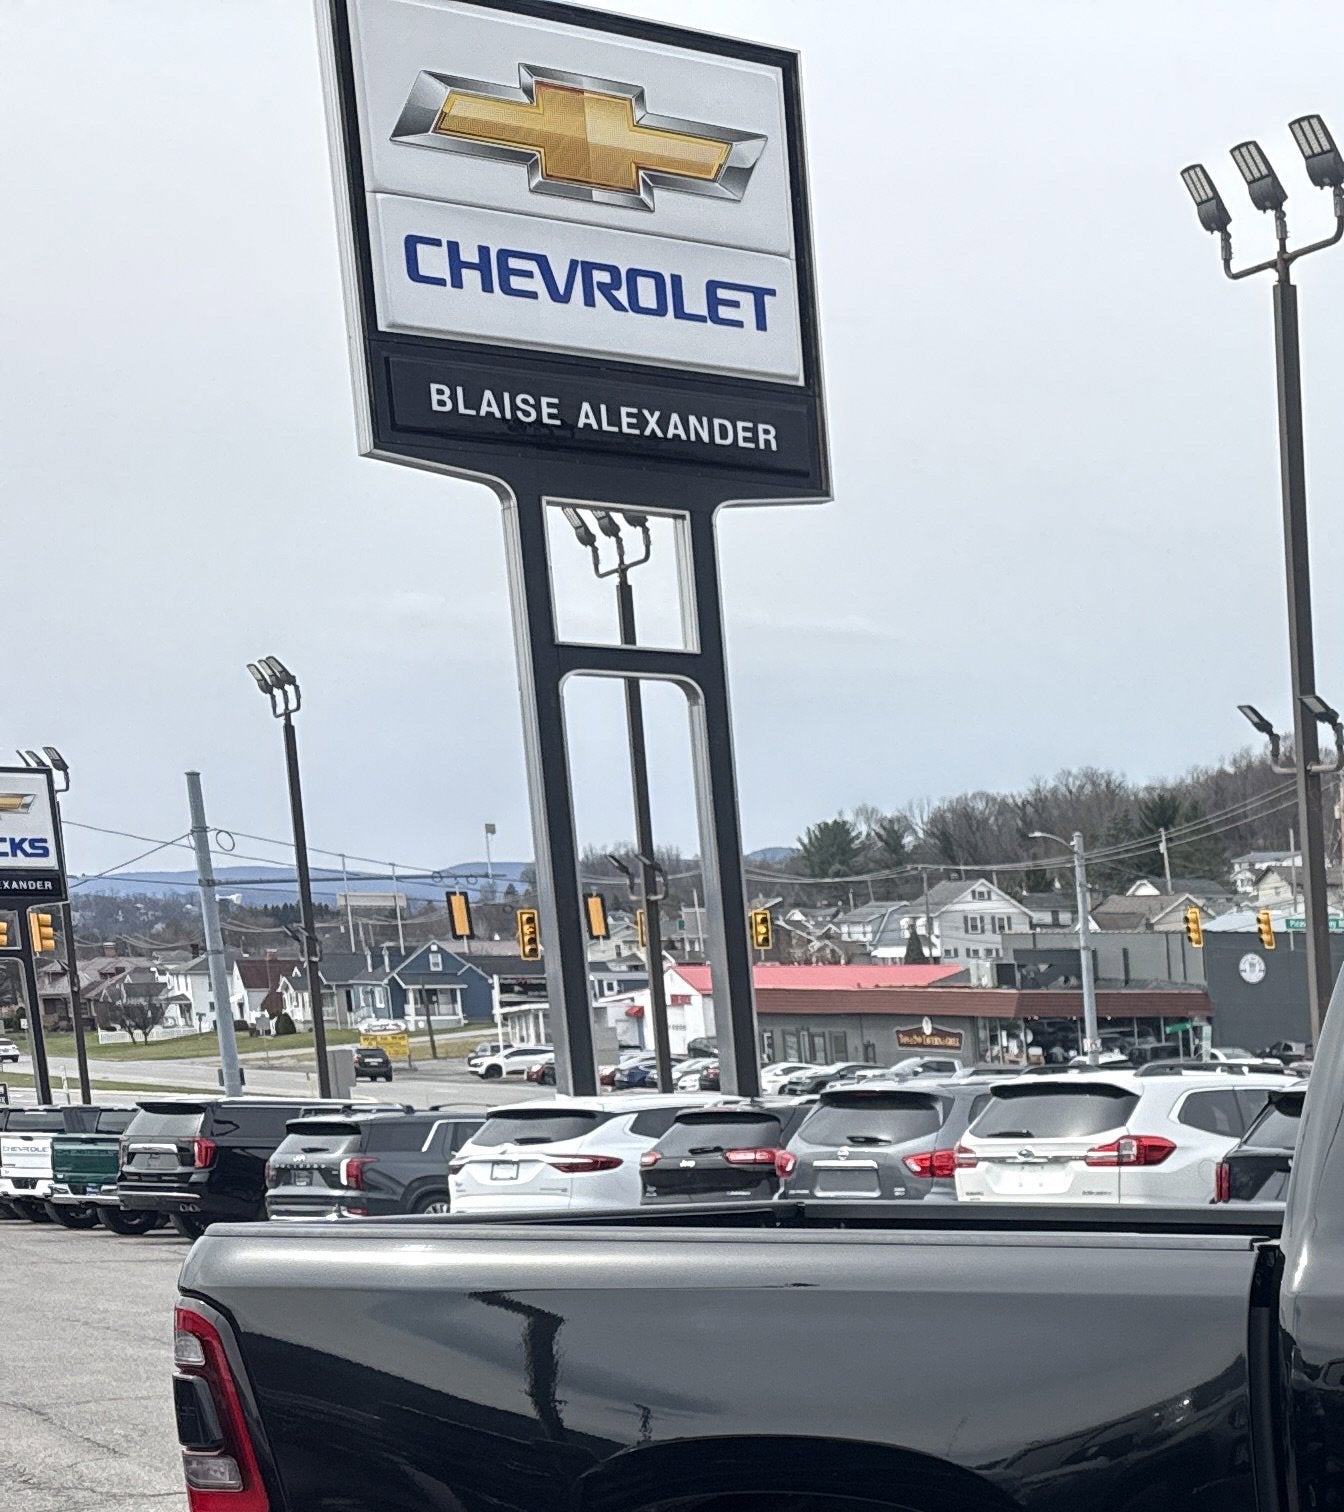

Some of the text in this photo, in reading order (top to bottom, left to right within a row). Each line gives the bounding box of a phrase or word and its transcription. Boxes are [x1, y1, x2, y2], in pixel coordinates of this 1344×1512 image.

[404, 234, 777, 332] CHEVROLET
[429, 382, 778, 451] BLAISE ALEXANDER
